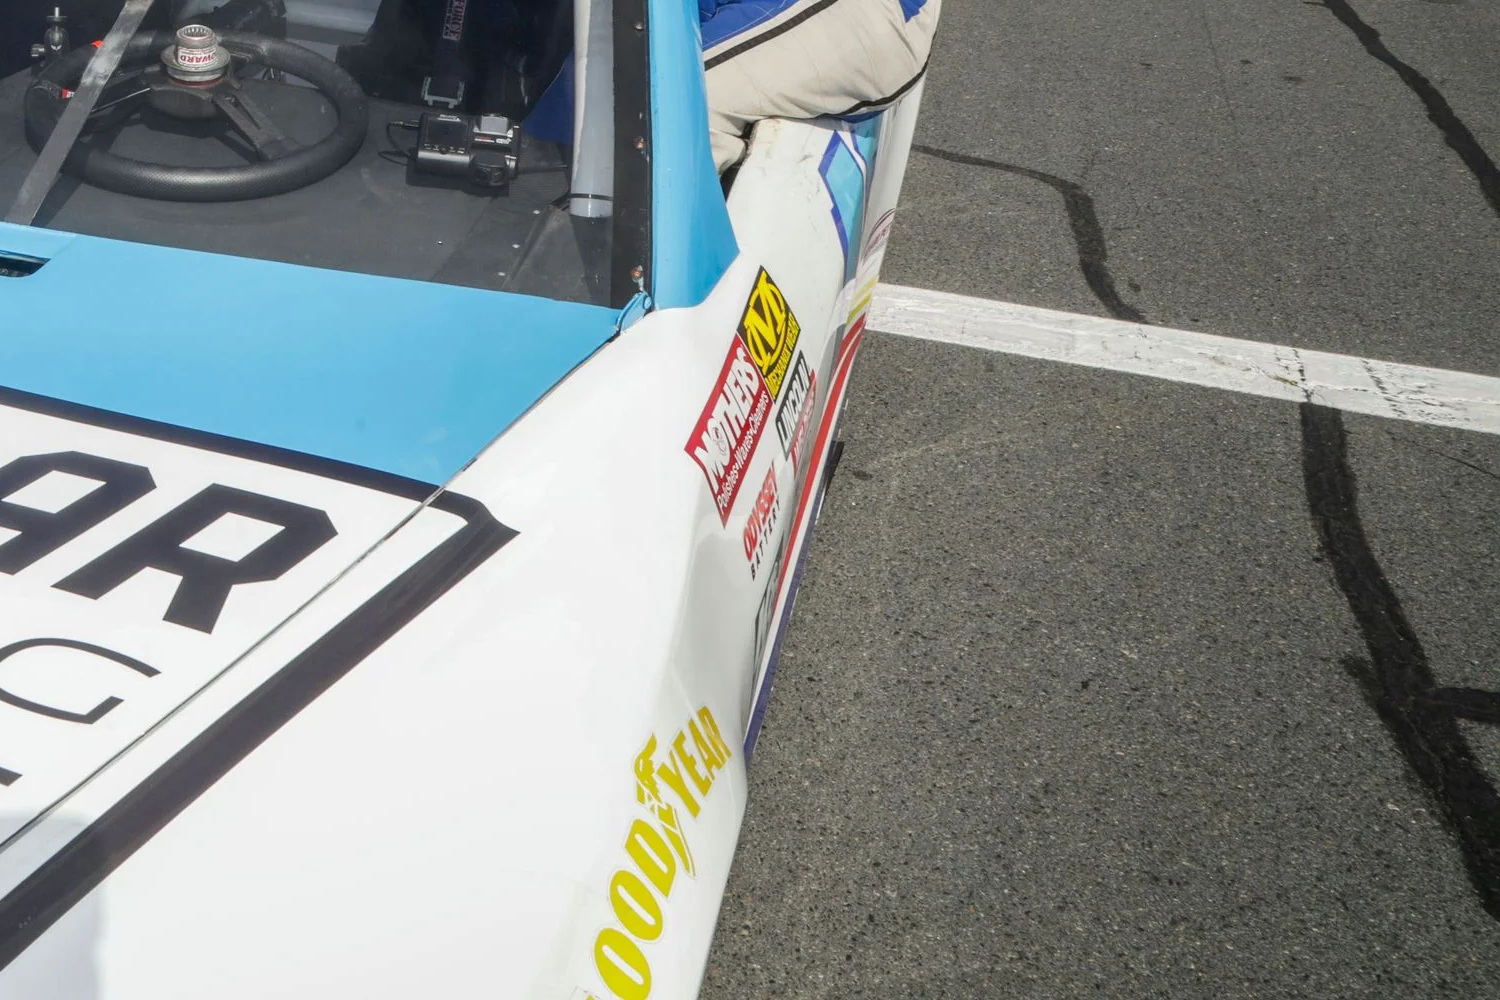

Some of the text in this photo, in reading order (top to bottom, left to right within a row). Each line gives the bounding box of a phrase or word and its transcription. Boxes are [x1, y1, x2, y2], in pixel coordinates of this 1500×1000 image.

[765, 311, 800, 400] MECHANIX WEAR
[694, 346, 759, 495] MOTHERS
[778, 358, 811, 453] LINCOLN
[743, 460, 778, 562] ODYSSEY
[750, 500, 781, 582] BATTERY
